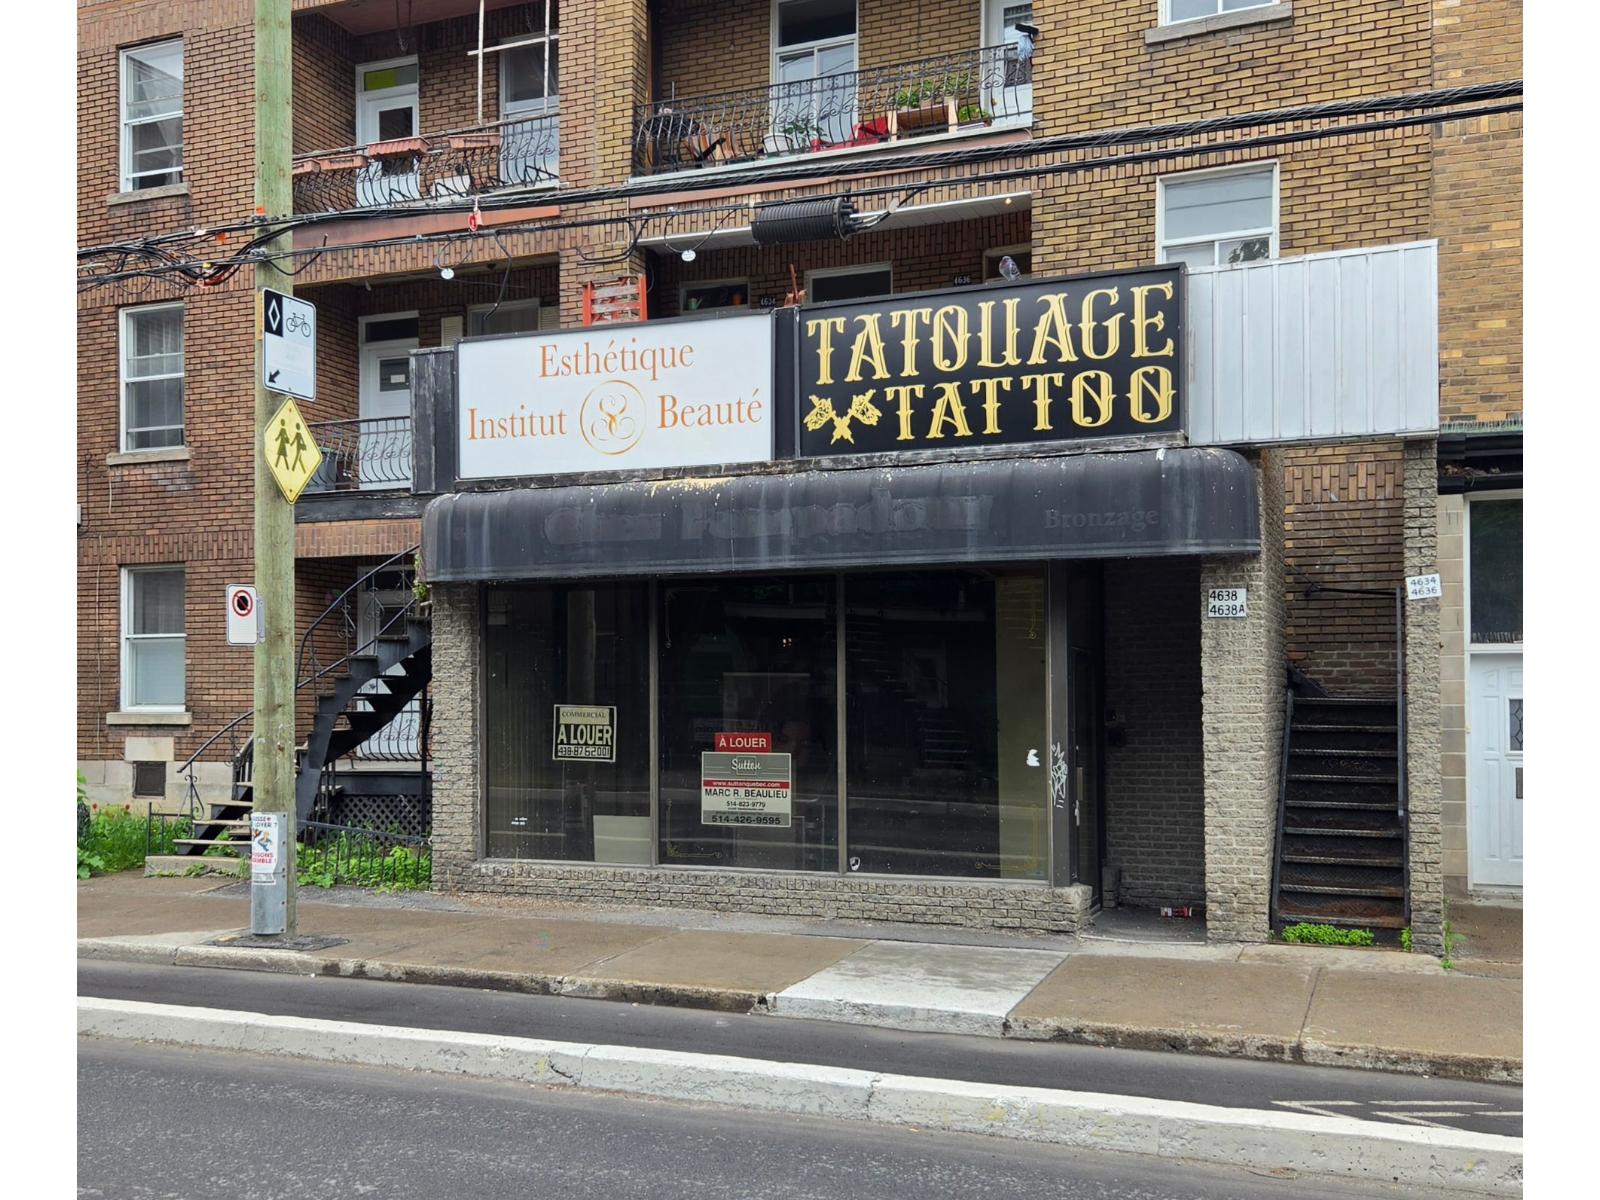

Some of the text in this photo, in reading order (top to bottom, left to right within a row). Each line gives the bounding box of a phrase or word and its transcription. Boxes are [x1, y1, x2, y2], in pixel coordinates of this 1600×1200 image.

[806, 280, 1175, 385] TATOUAGE
[538, 337, 695, 381] Esthétique
[884, 365, 1177, 441] TATTOO
[467, 387, 763, 441] Institut Beauté
[1043, 508, 1160, 532] Bronzage
[1410, 576, 1437, 586] 4634
[1209, 590, 1238, 602] 4638
[1411, 586, 1438, 596] 4636
[1209, 604, 1246, 616] 4638A
[561, 711, 607, 719] COMMERCIAL
[570, 724, 613, 746] LOUER
[719, 735, 767, 748] À LOUER
[731, 758, 762, 770] Sutton
[704, 788, 731, 797] MARC
[744, 789, 788, 798] BEAULIEU
[711, 815, 781, 825] 514-426-9595
